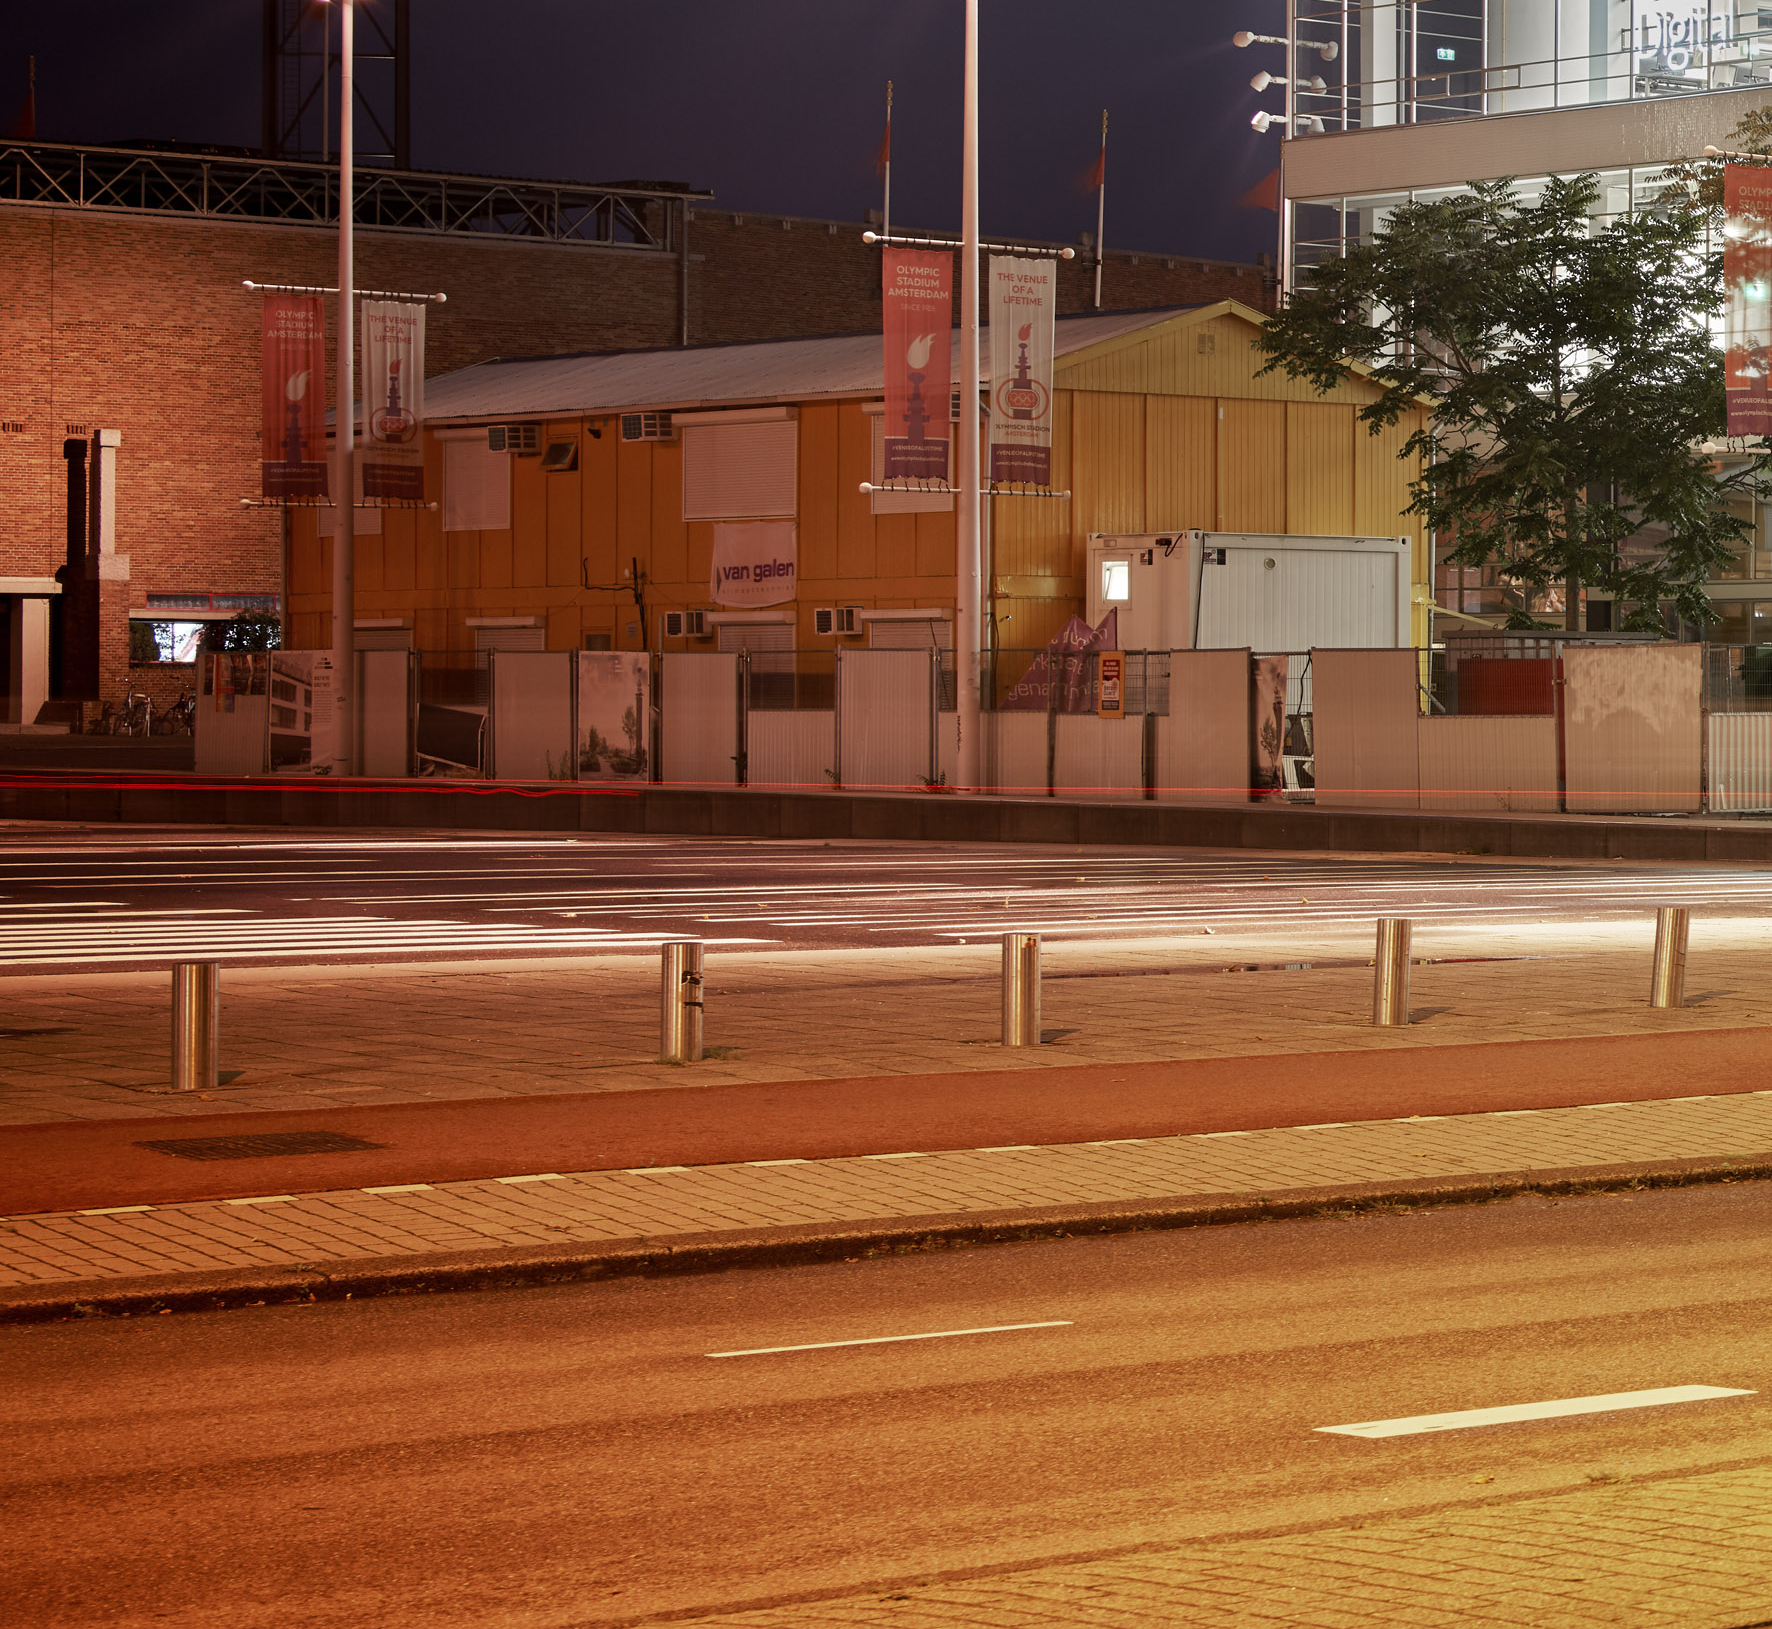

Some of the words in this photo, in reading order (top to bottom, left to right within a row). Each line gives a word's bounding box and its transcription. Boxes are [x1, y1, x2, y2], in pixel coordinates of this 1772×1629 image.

[896, 265, 940, 278] OLYMPIC
[896, 276, 940, 289] STADIUM
[997, 272, 1015, 282] THE
[1016, 274, 1049, 285] VENUE
[887, 288, 950, 301] AMSTERDAM
[1011, 285, 1025, 295] OF
[1027, 286, 1034, 295] A
[1003, 295, 1044, 307] LIFETIME
[275, 310, 314, 320] OLYMPIC
[369, 314, 387, 323] THE
[388, 316, 418, 326] VENUE
[276, 320, 314, 330] STADIUM
[267, 329, 322, 341] AMSTERDAM
[374, 335, 413, 345] LIFETIME
[723, 565, 750, 580] van
[753, 558, 795, 583] galen
